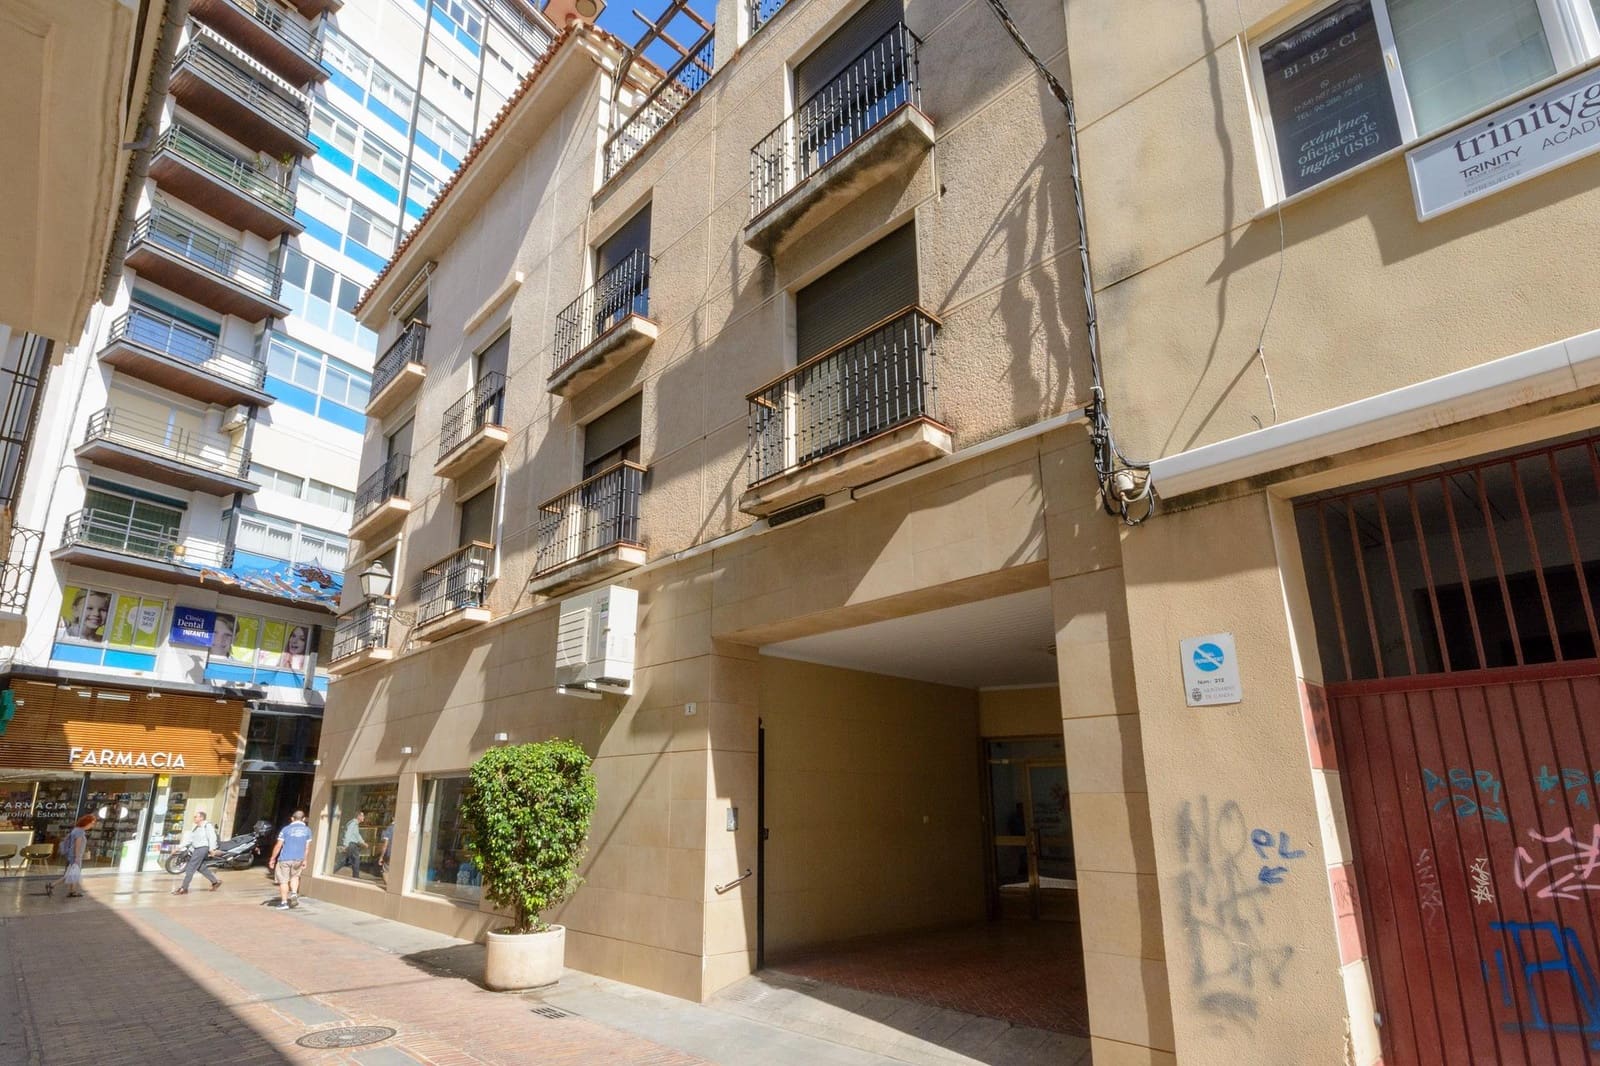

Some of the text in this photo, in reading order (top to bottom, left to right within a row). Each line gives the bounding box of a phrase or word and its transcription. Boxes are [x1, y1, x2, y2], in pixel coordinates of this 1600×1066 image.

[1309, 47, 1329, 65] B2
[1339, 31, 1359, 48] C1
[1297, 121, 1378, 165] oficiales de
[1343, 132, 1380, 157] (ISE)
[1460, 145, 1522, 178] TRINITY
[177, 618, 205, 630] Dental
[182, 629, 209, 638] INFANTIL
[69, 746, 185, 768] FARMACIA
